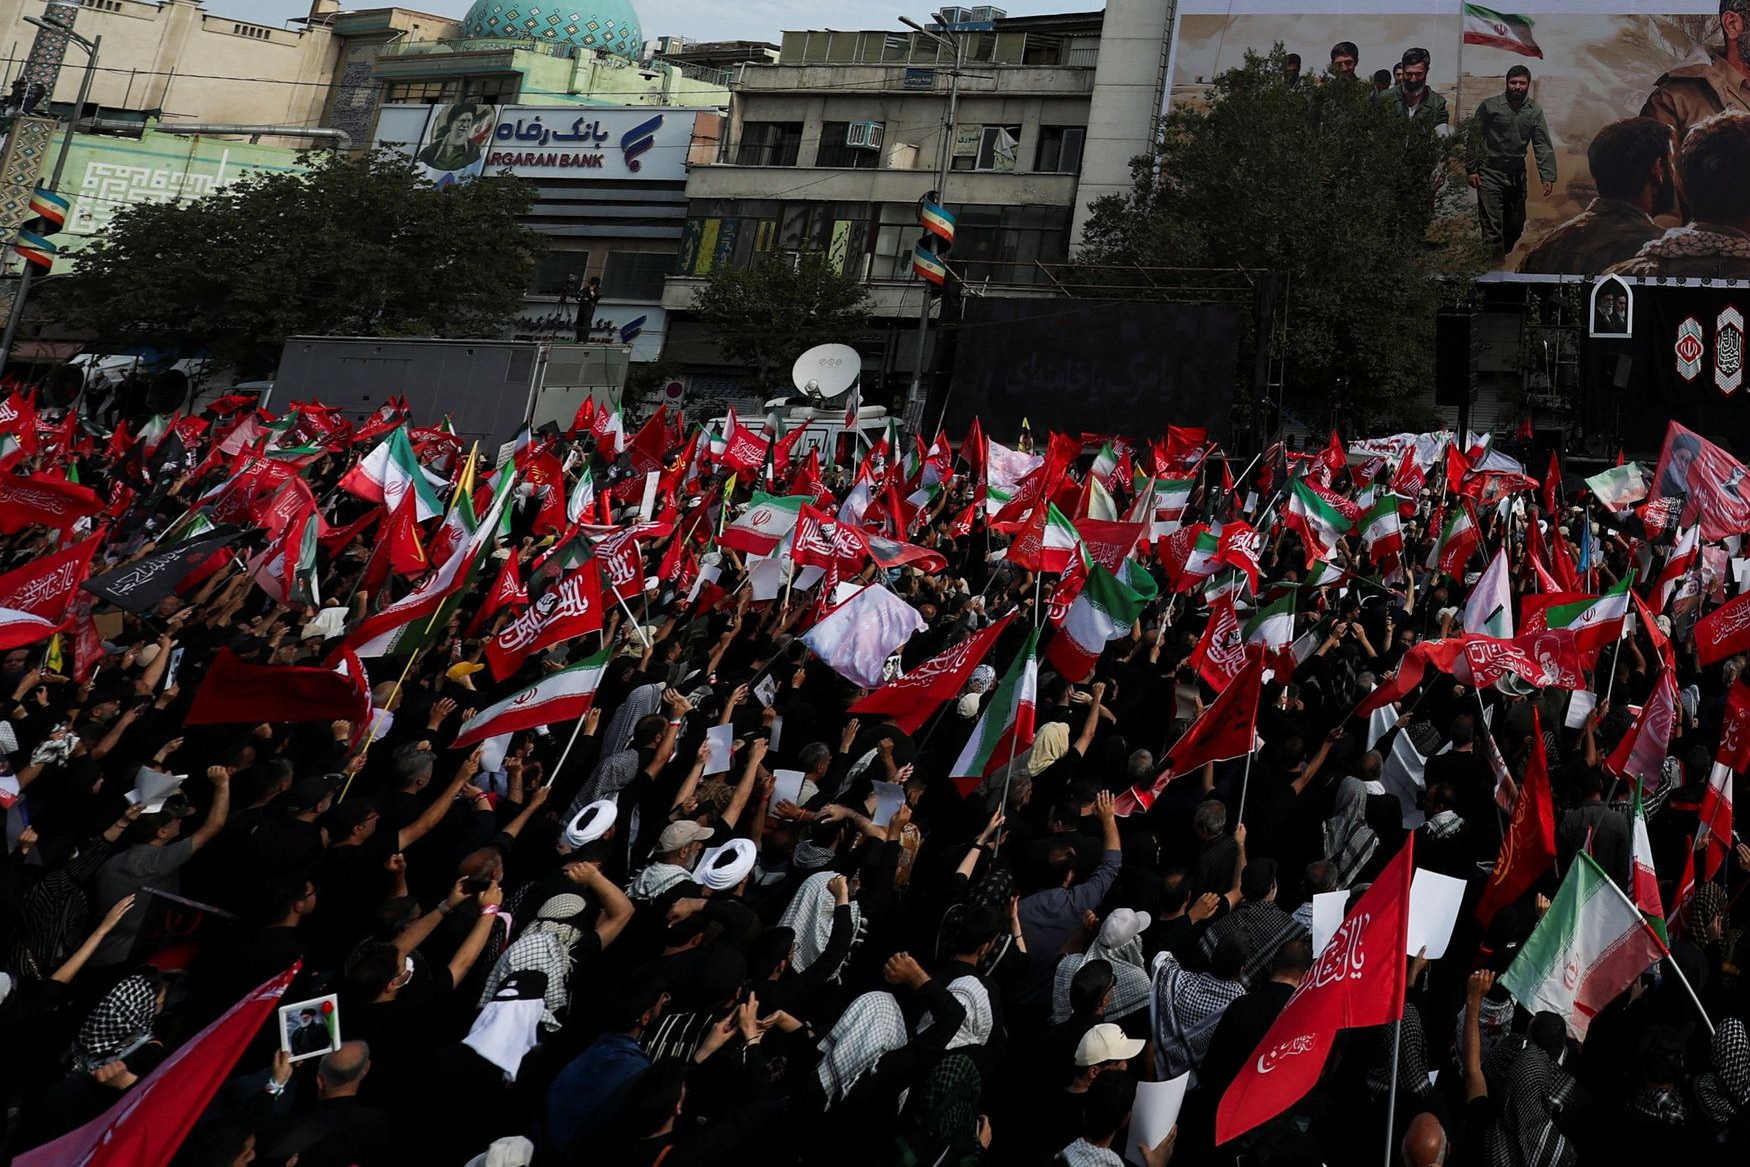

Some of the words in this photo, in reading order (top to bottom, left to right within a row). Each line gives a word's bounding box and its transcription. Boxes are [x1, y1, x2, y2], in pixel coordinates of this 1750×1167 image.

[496, 116, 550, 146] رفاه
[552, 116, 609, 150] بانک
[559, 153, 604, 169] BANK
[807, 438, 827, 450] TV
